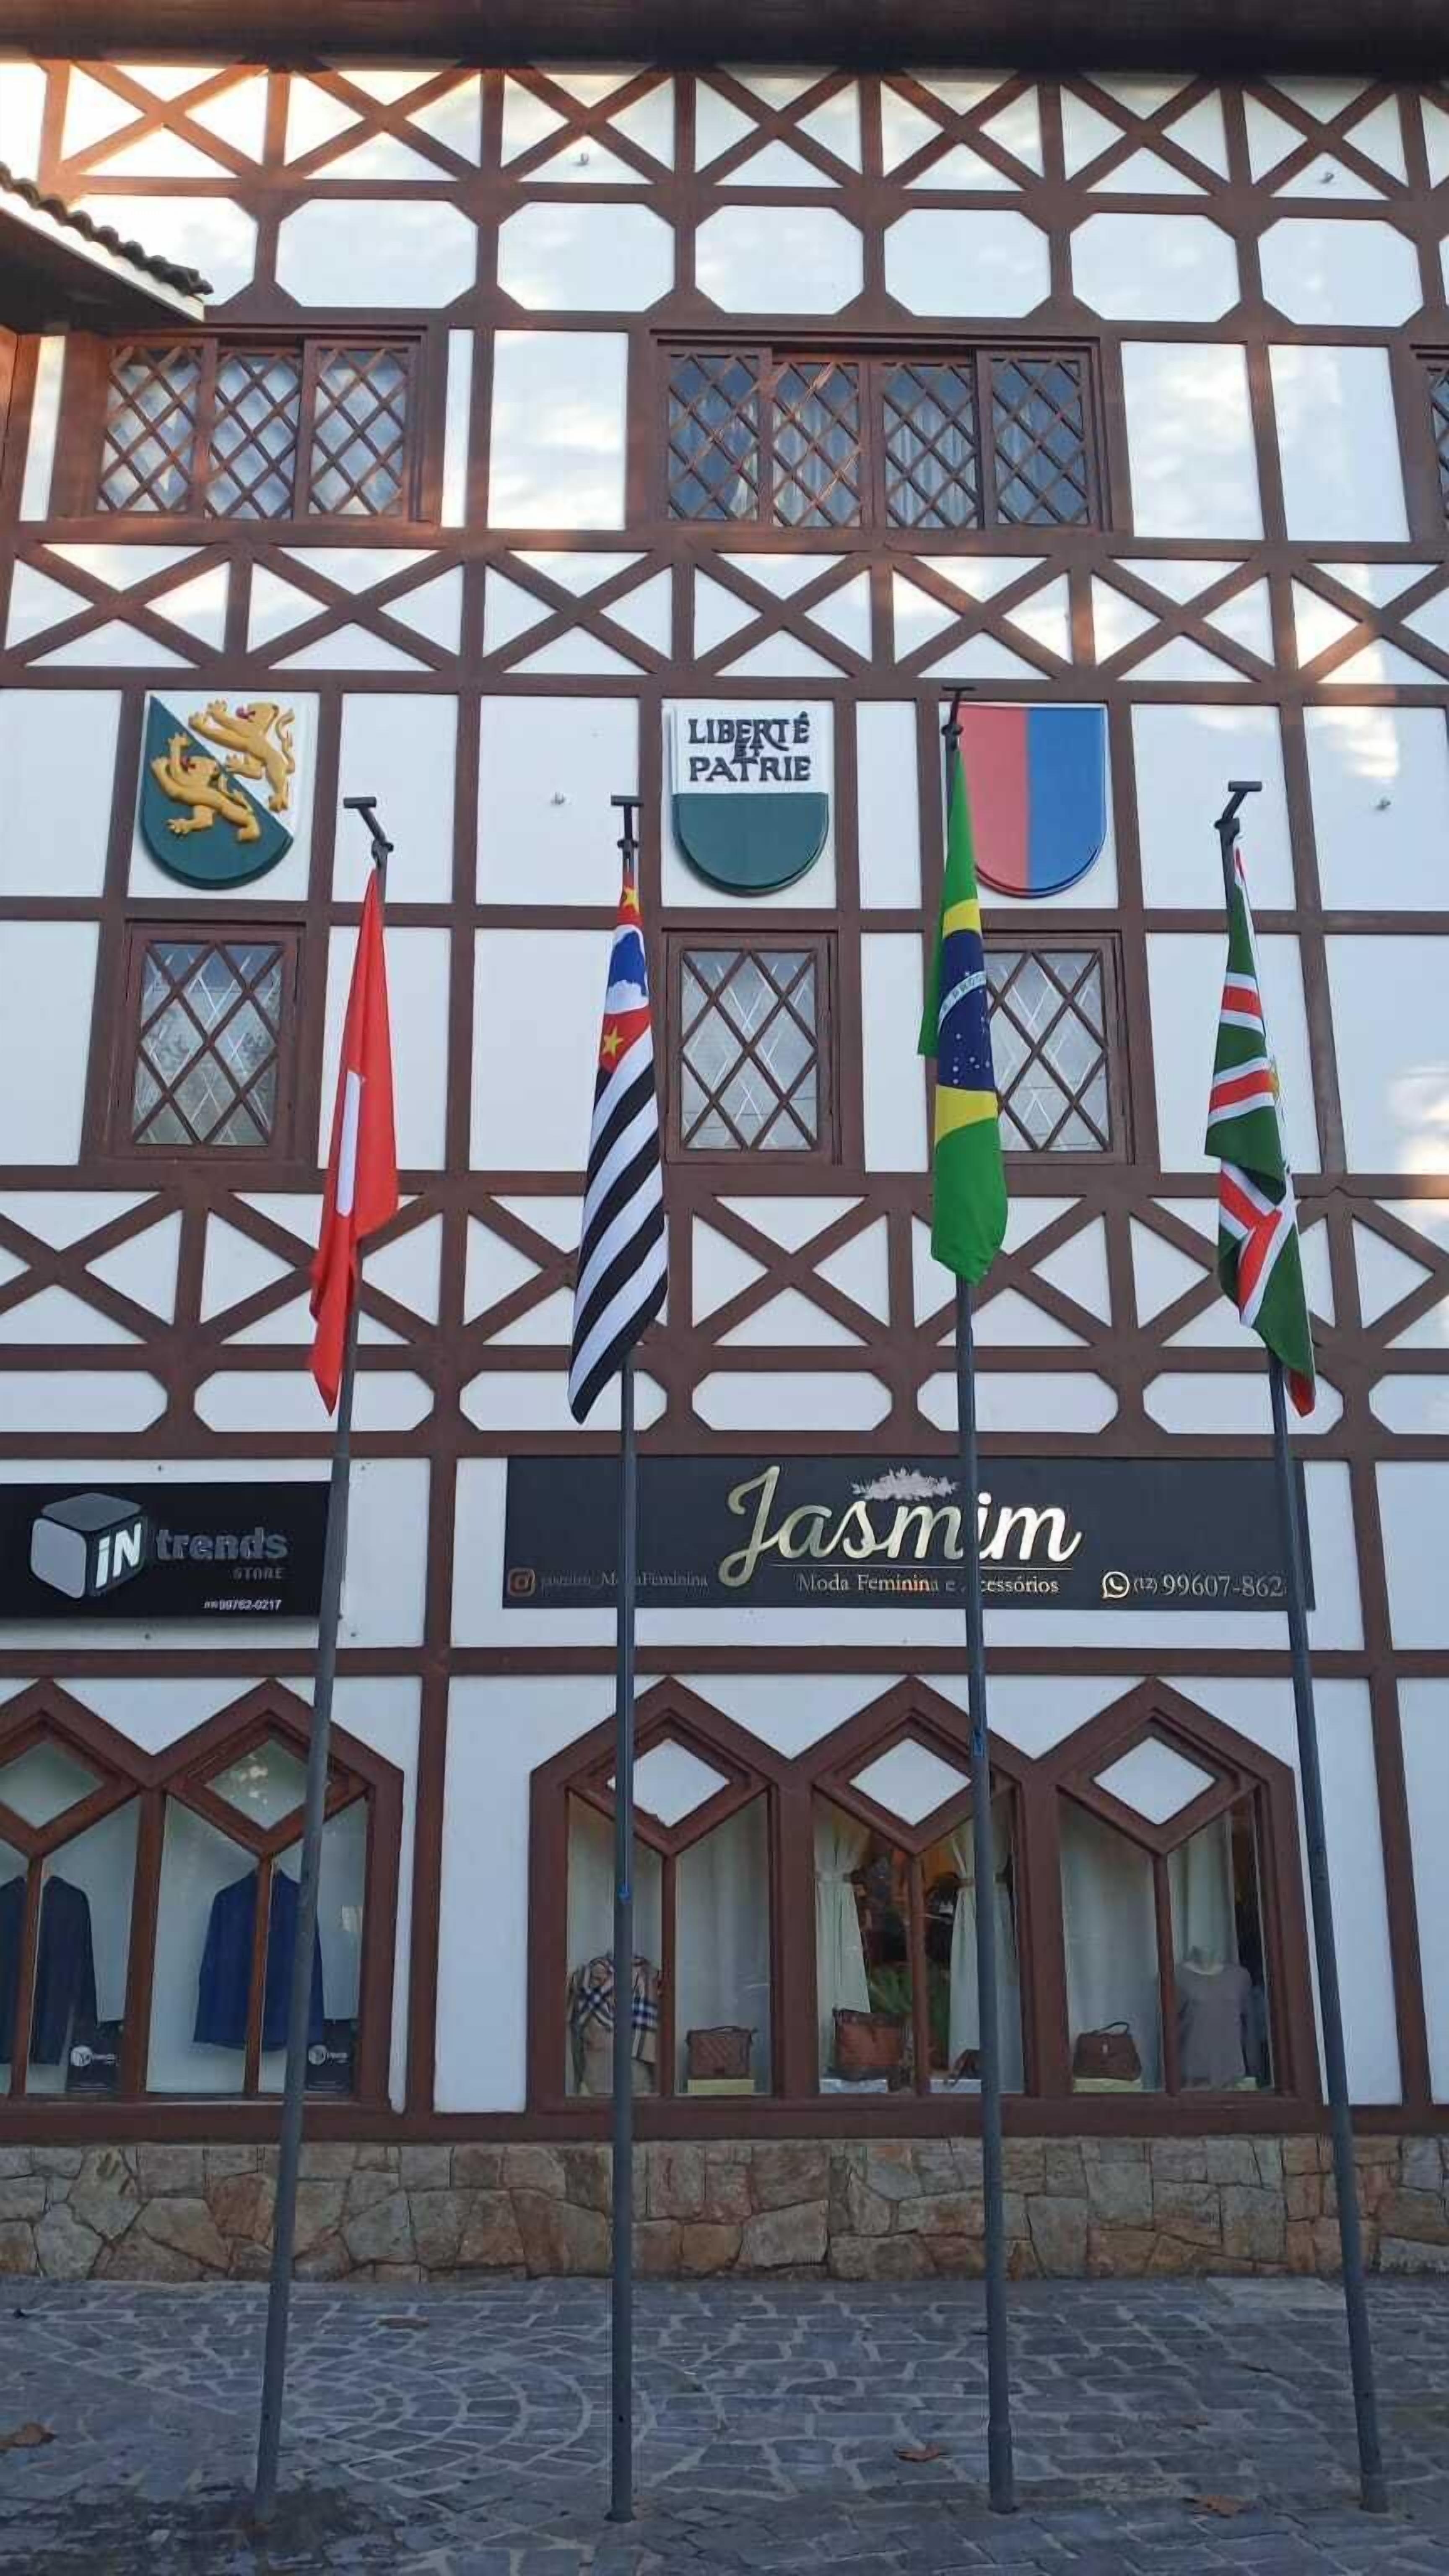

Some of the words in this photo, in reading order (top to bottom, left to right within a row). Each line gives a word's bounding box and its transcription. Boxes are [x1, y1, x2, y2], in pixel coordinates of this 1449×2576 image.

[689, 756, 811, 782] PATRIE
[718, 1465, 1082, 1587] Jasmim
[156, 1527, 288, 1561] trends
[231, 1567, 283, 1580] STORE
[798, 1573, 849, 1591] Moda
[858, 1573, 940, 1591] Feminina
[960, 1575, 1061, 1592] cessórios
[1162, 1574, 1287, 1597] 99607-862
